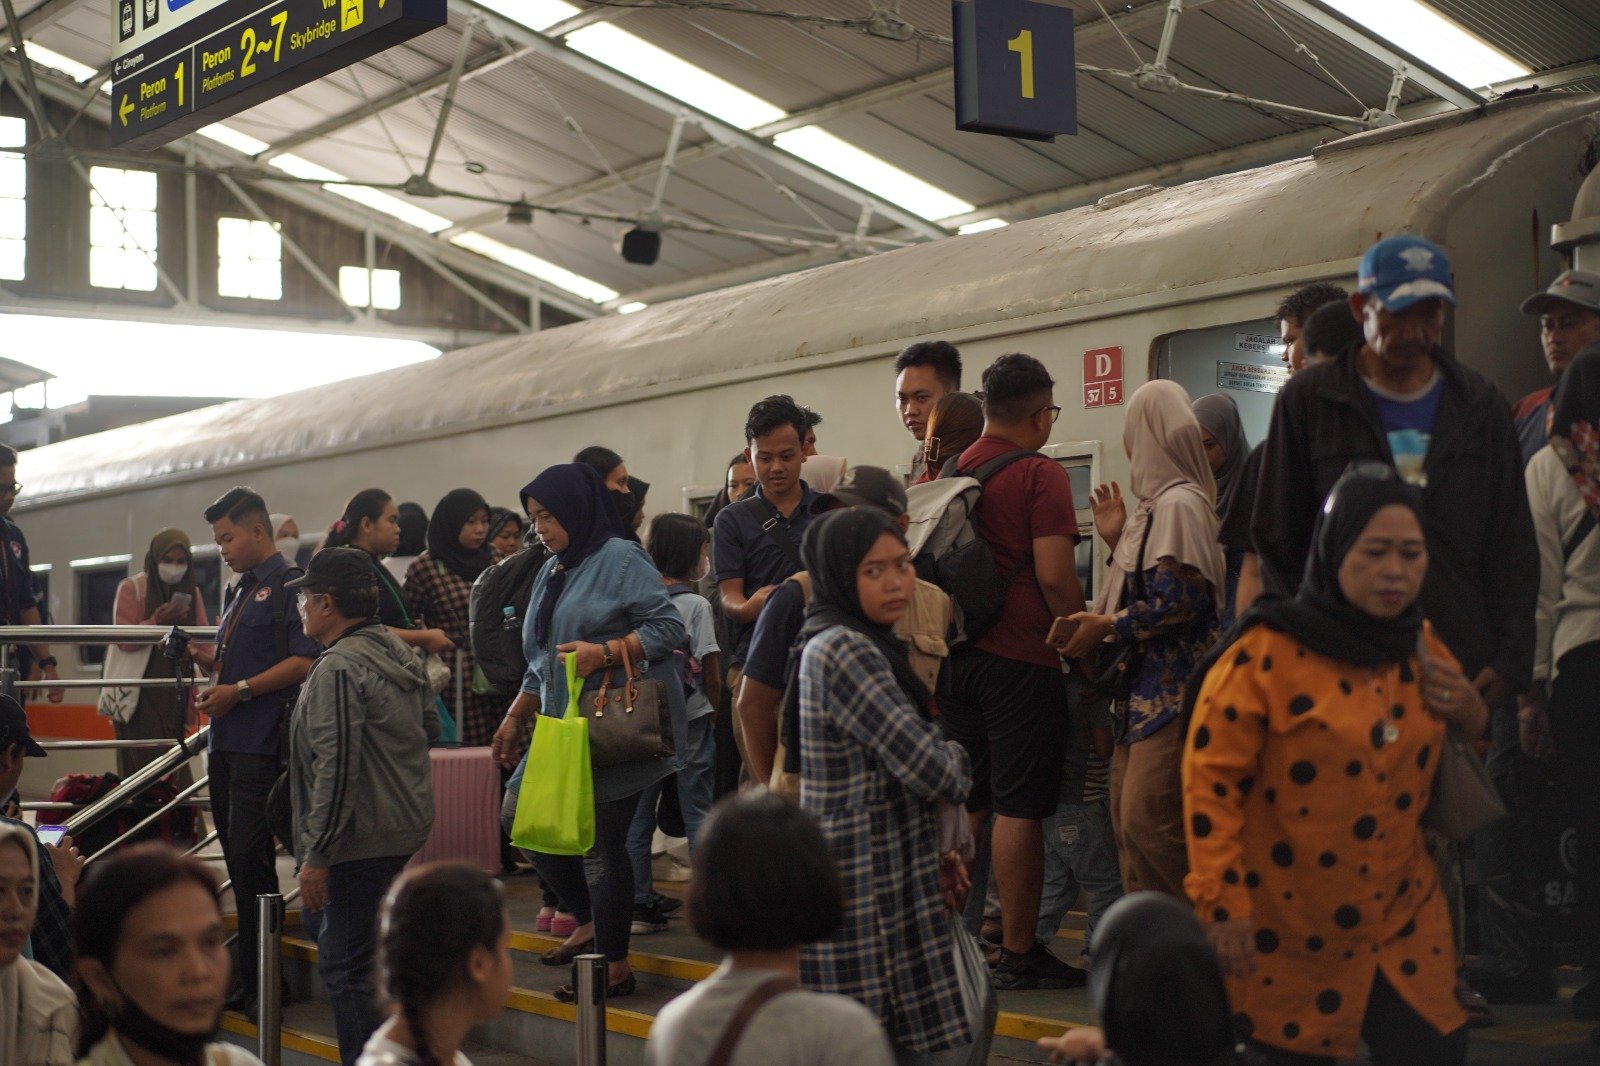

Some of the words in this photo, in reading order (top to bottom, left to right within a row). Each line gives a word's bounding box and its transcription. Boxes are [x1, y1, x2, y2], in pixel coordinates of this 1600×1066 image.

[203, 47, 231, 71] Peron
[241, 11, 288, 78] 2~7
[290, 19, 336, 50] Skybridge
[1007, 29, 1035, 99] 1
[141, 78, 166, 101] Peron
[175, 62, 184, 106] 1
[202, 70, 235, 93] Platforms
[140, 102, 167, 121] Platform
[1245, 336, 1276, 345] JAGALAH
[1095, 354, 1112, 377] D
[1087, 389, 1100, 403] 37
[1109, 387, 1117, 400] 5
